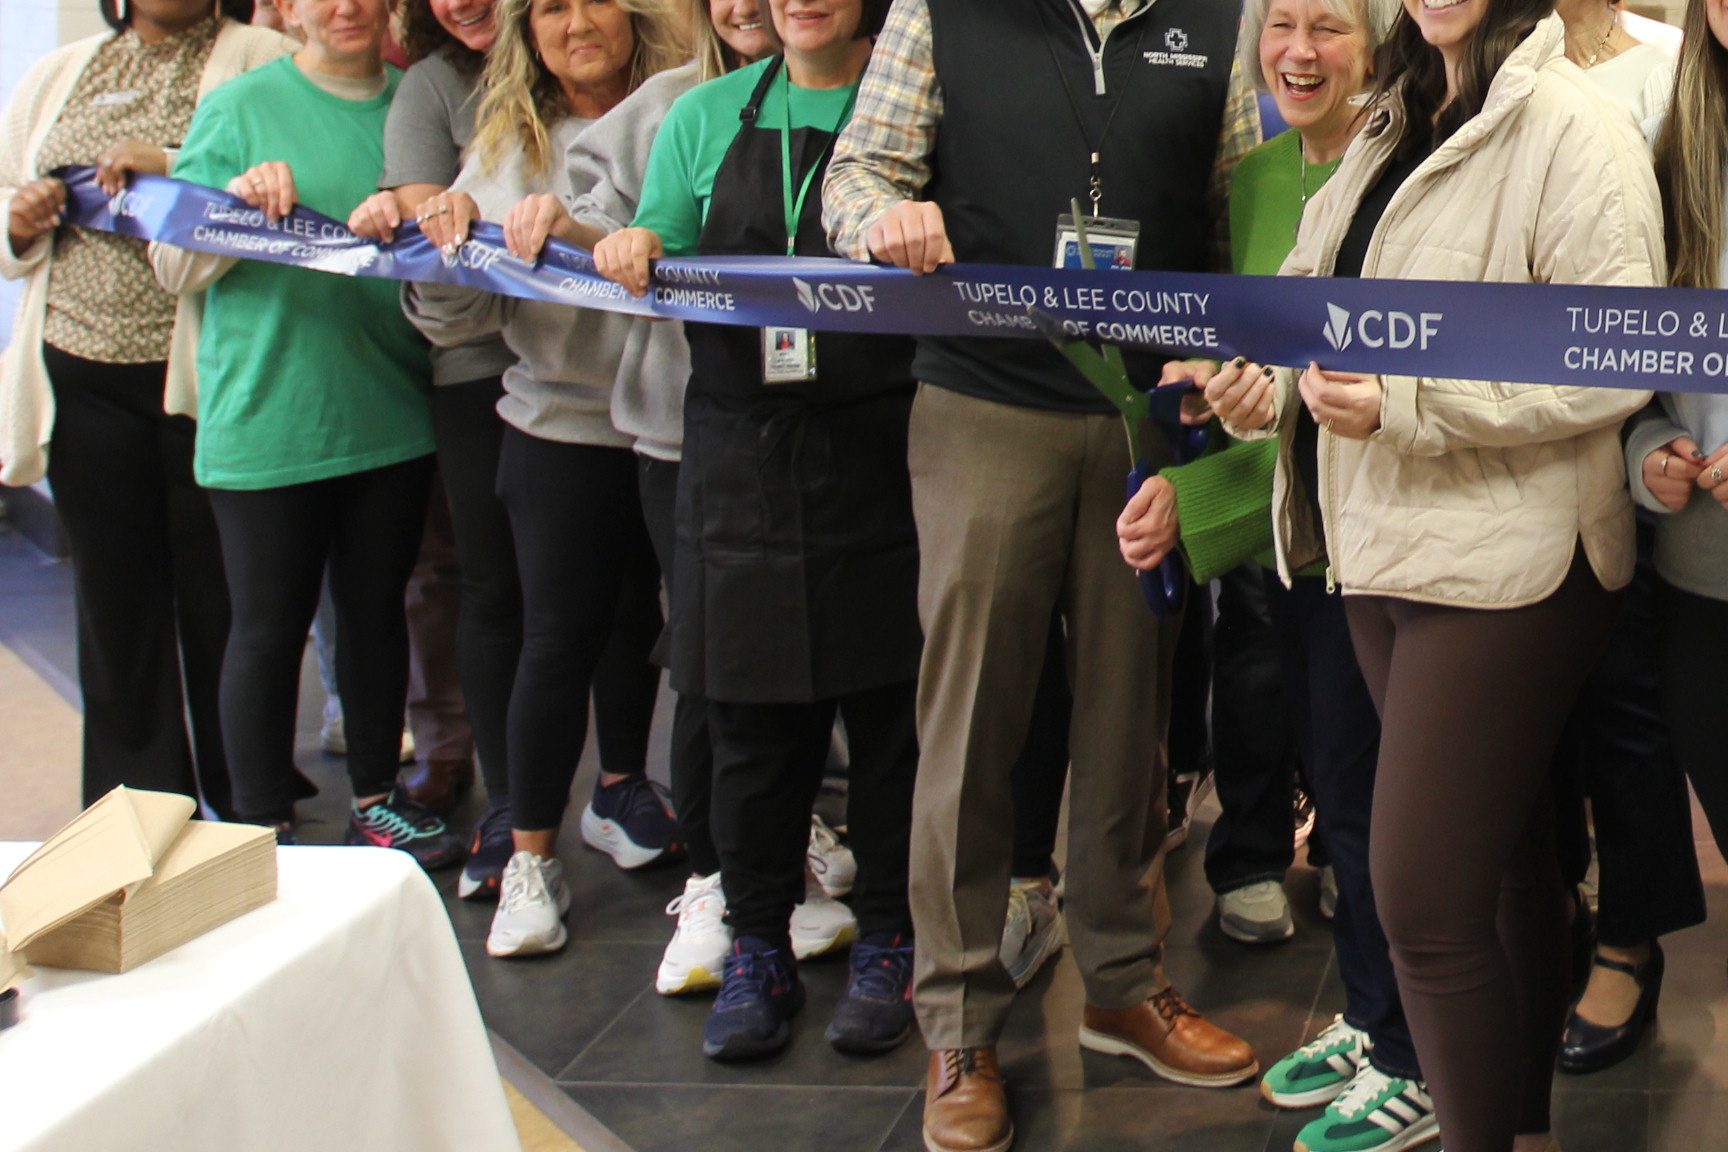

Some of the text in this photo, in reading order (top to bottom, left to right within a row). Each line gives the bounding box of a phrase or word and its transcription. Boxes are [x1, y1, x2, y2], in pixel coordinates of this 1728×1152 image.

[193, 226, 269, 251] CHAMBER
[268, 240, 294, 255] OF
[284, 217, 316, 238] LEE
[654, 264, 720, 286] COUNTY
[654, 287, 735, 311] COMMERCE
[818, 283, 876, 313] CDF
[953, 281, 1210, 315] TUPELO & LEE COUNTY
[968, 309, 1219, 347] CHAMB OF COMMERCE
[1357, 310, 1443, 351] CDF
[1566, 307, 1680, 339] TUPELO
[1689, 312, 1708, 339] &
[1563, 347, 1695, 376] CHAMBER
